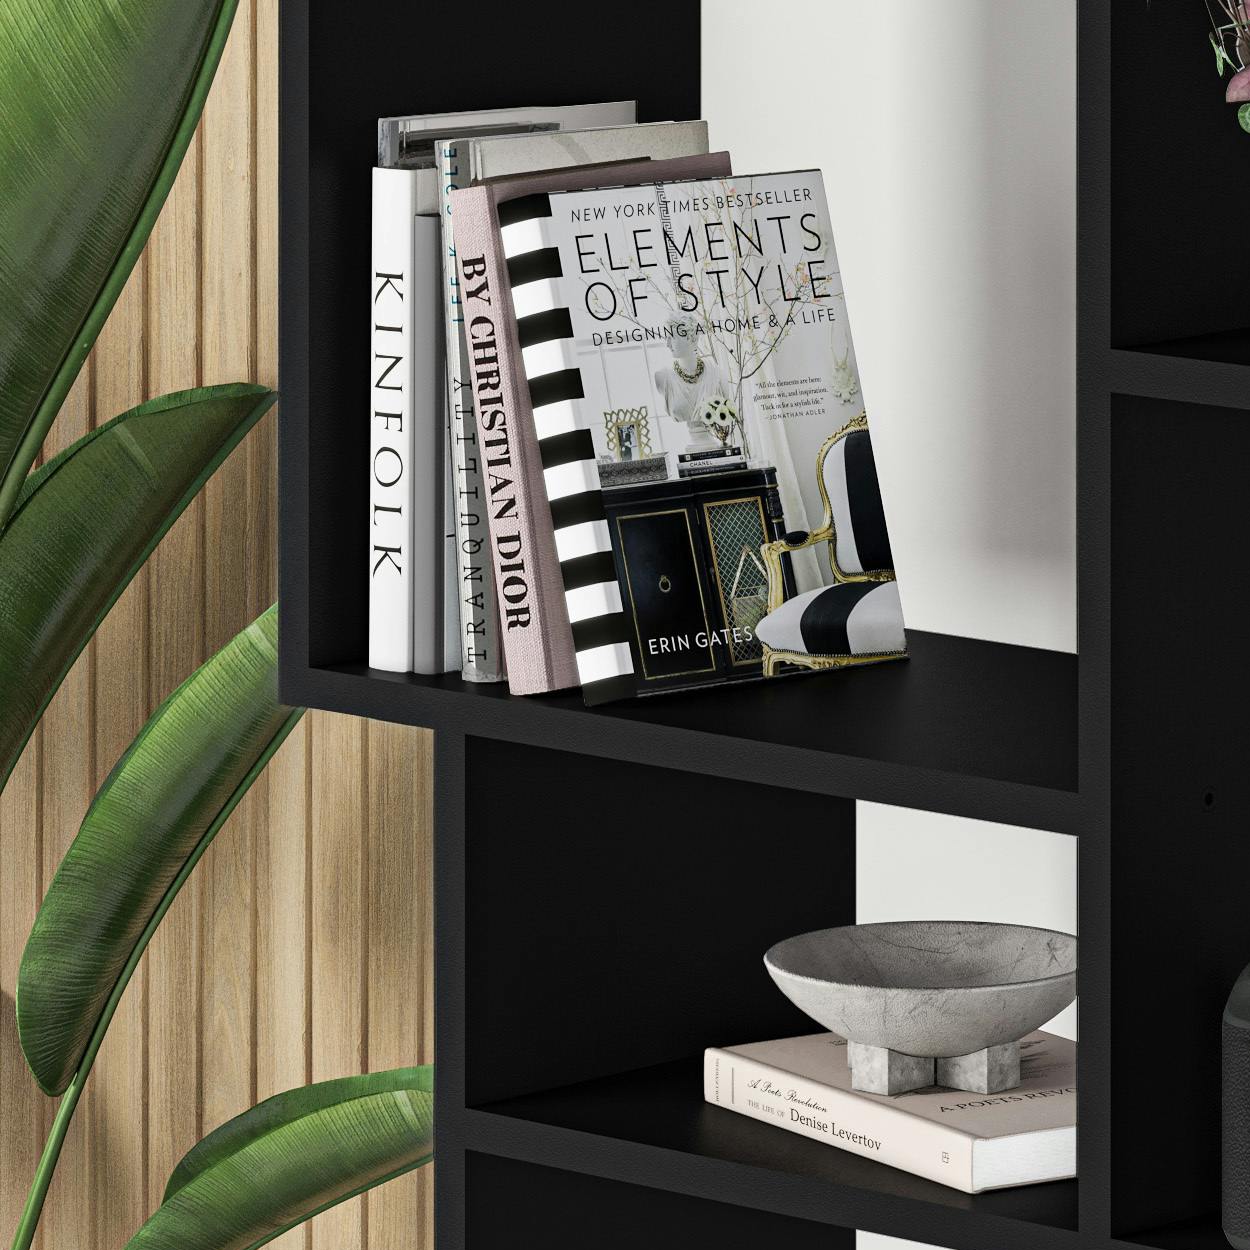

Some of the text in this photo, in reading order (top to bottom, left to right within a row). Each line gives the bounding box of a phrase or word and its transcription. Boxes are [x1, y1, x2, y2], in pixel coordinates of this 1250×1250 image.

[571, 188, 813, 222] NEW YORK TIMES BESTSELLER
[575, 213, 821, 274] ELEMENTS
[584, 260, 831, 321] OF STYLE
[592, 308, 836, 346] DESIGNING A HOME & A LIFE
[372, 270, 404, 580] KINFOLK
[462, 253, 531, 632] BY CHRISTIAN DIOR
[453, 378, 486, 663] TRANQUILITY
[648, 625, 753, 655] ERIN GATES
[784, 1089, 829, 1113] Revolution
[939, 1105, 954, 1113] A
[956, 1094, 1023, 1109] POETS
[789, 1108, 829, 1134] Denise
[831, 1122, 882, 1151] Levertov
